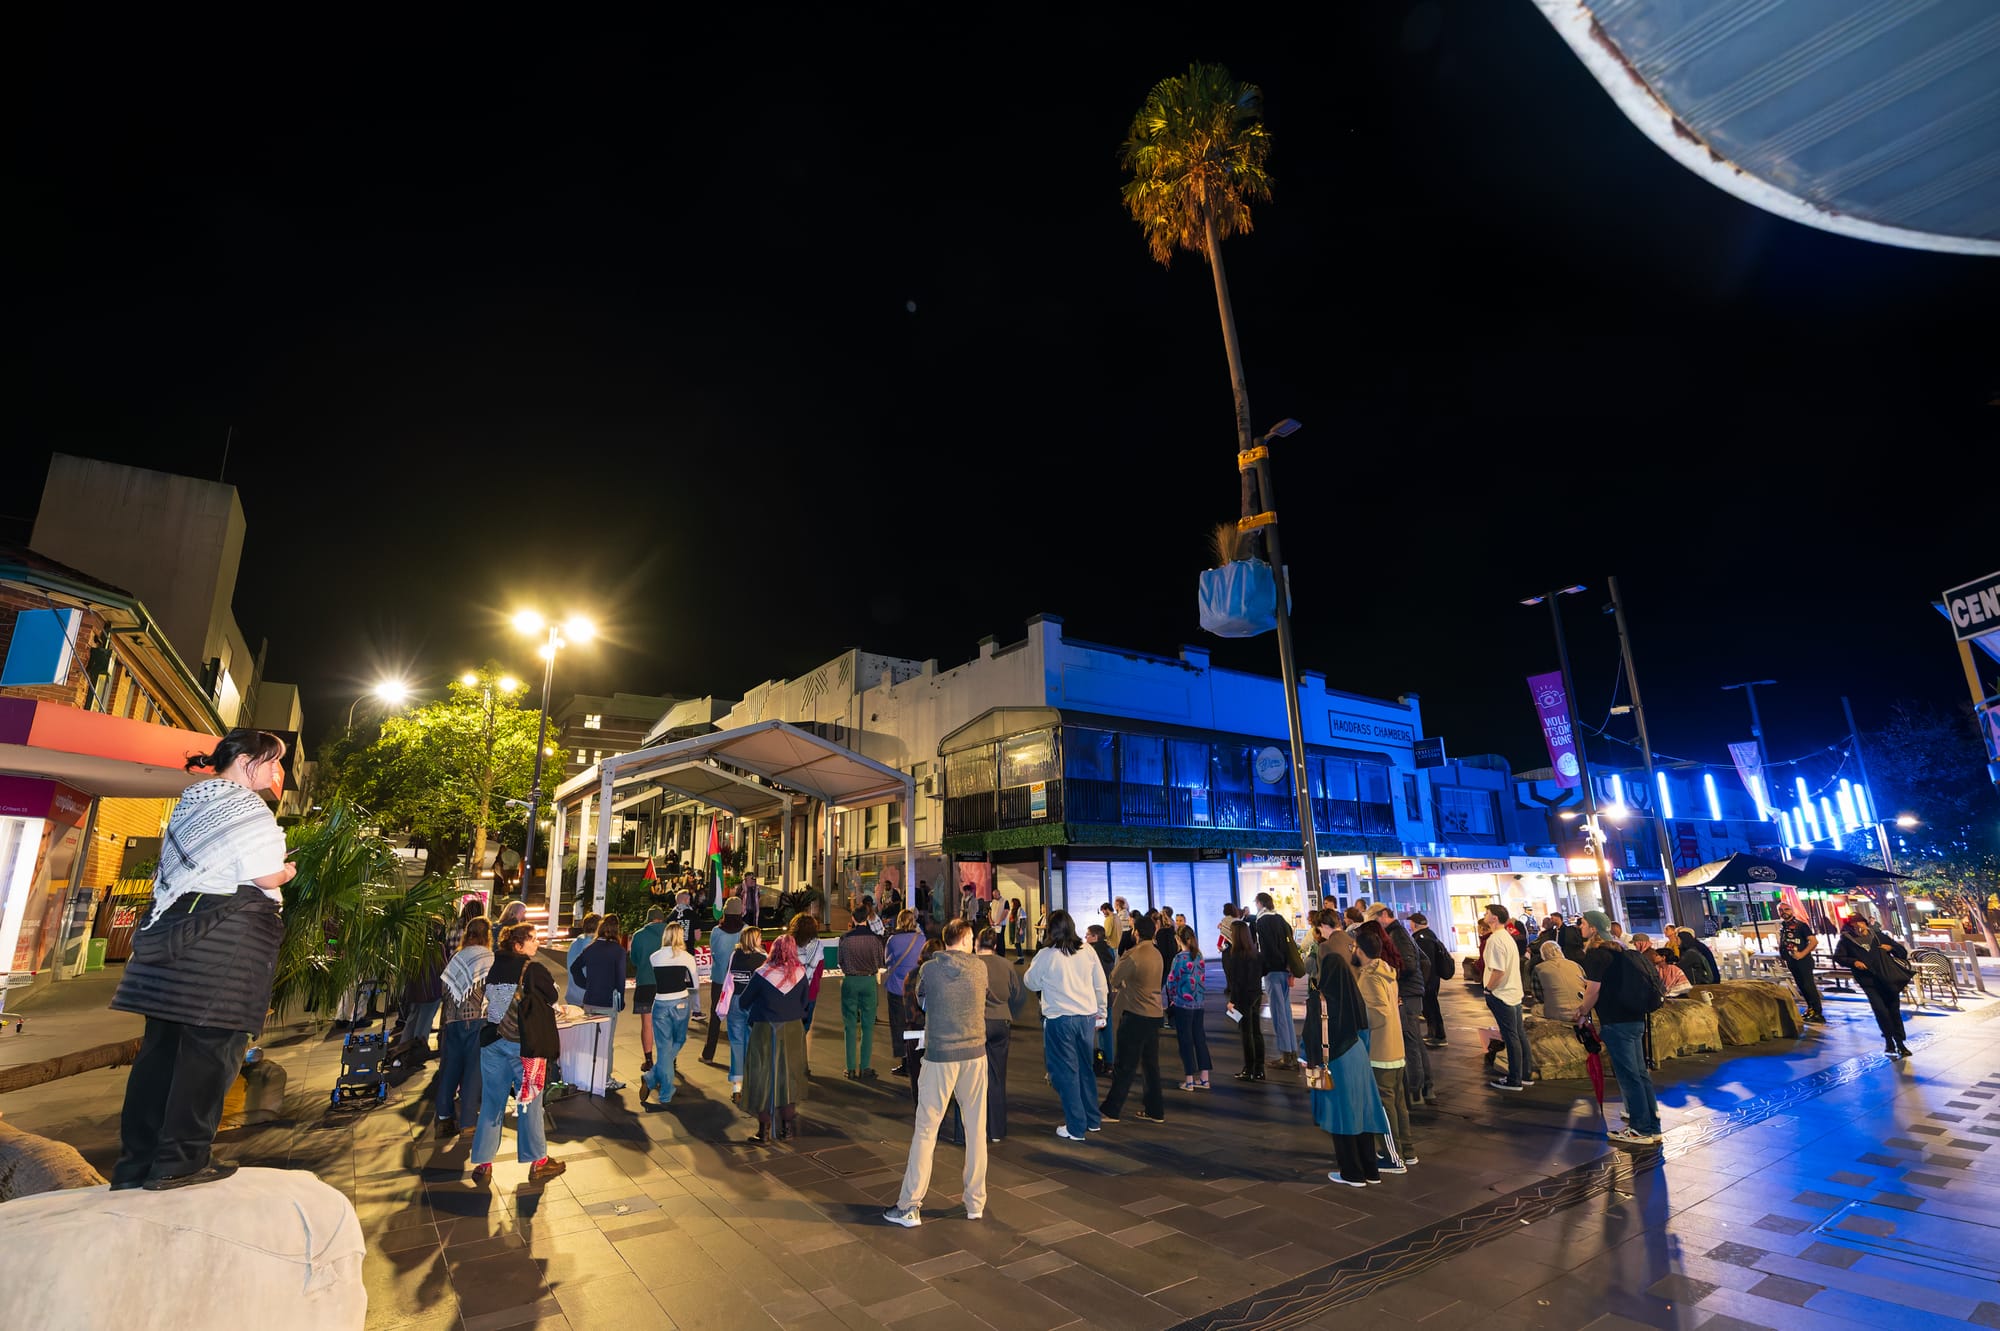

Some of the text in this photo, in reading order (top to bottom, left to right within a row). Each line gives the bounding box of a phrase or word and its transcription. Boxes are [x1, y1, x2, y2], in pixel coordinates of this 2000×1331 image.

[1544, 714, 1568, 727] WOLL
[1374, 726, 1411, 742] CHAMBERS
[1450, 860, 1479, 872] Gong
[1482, 860, 1501, 869] cha
